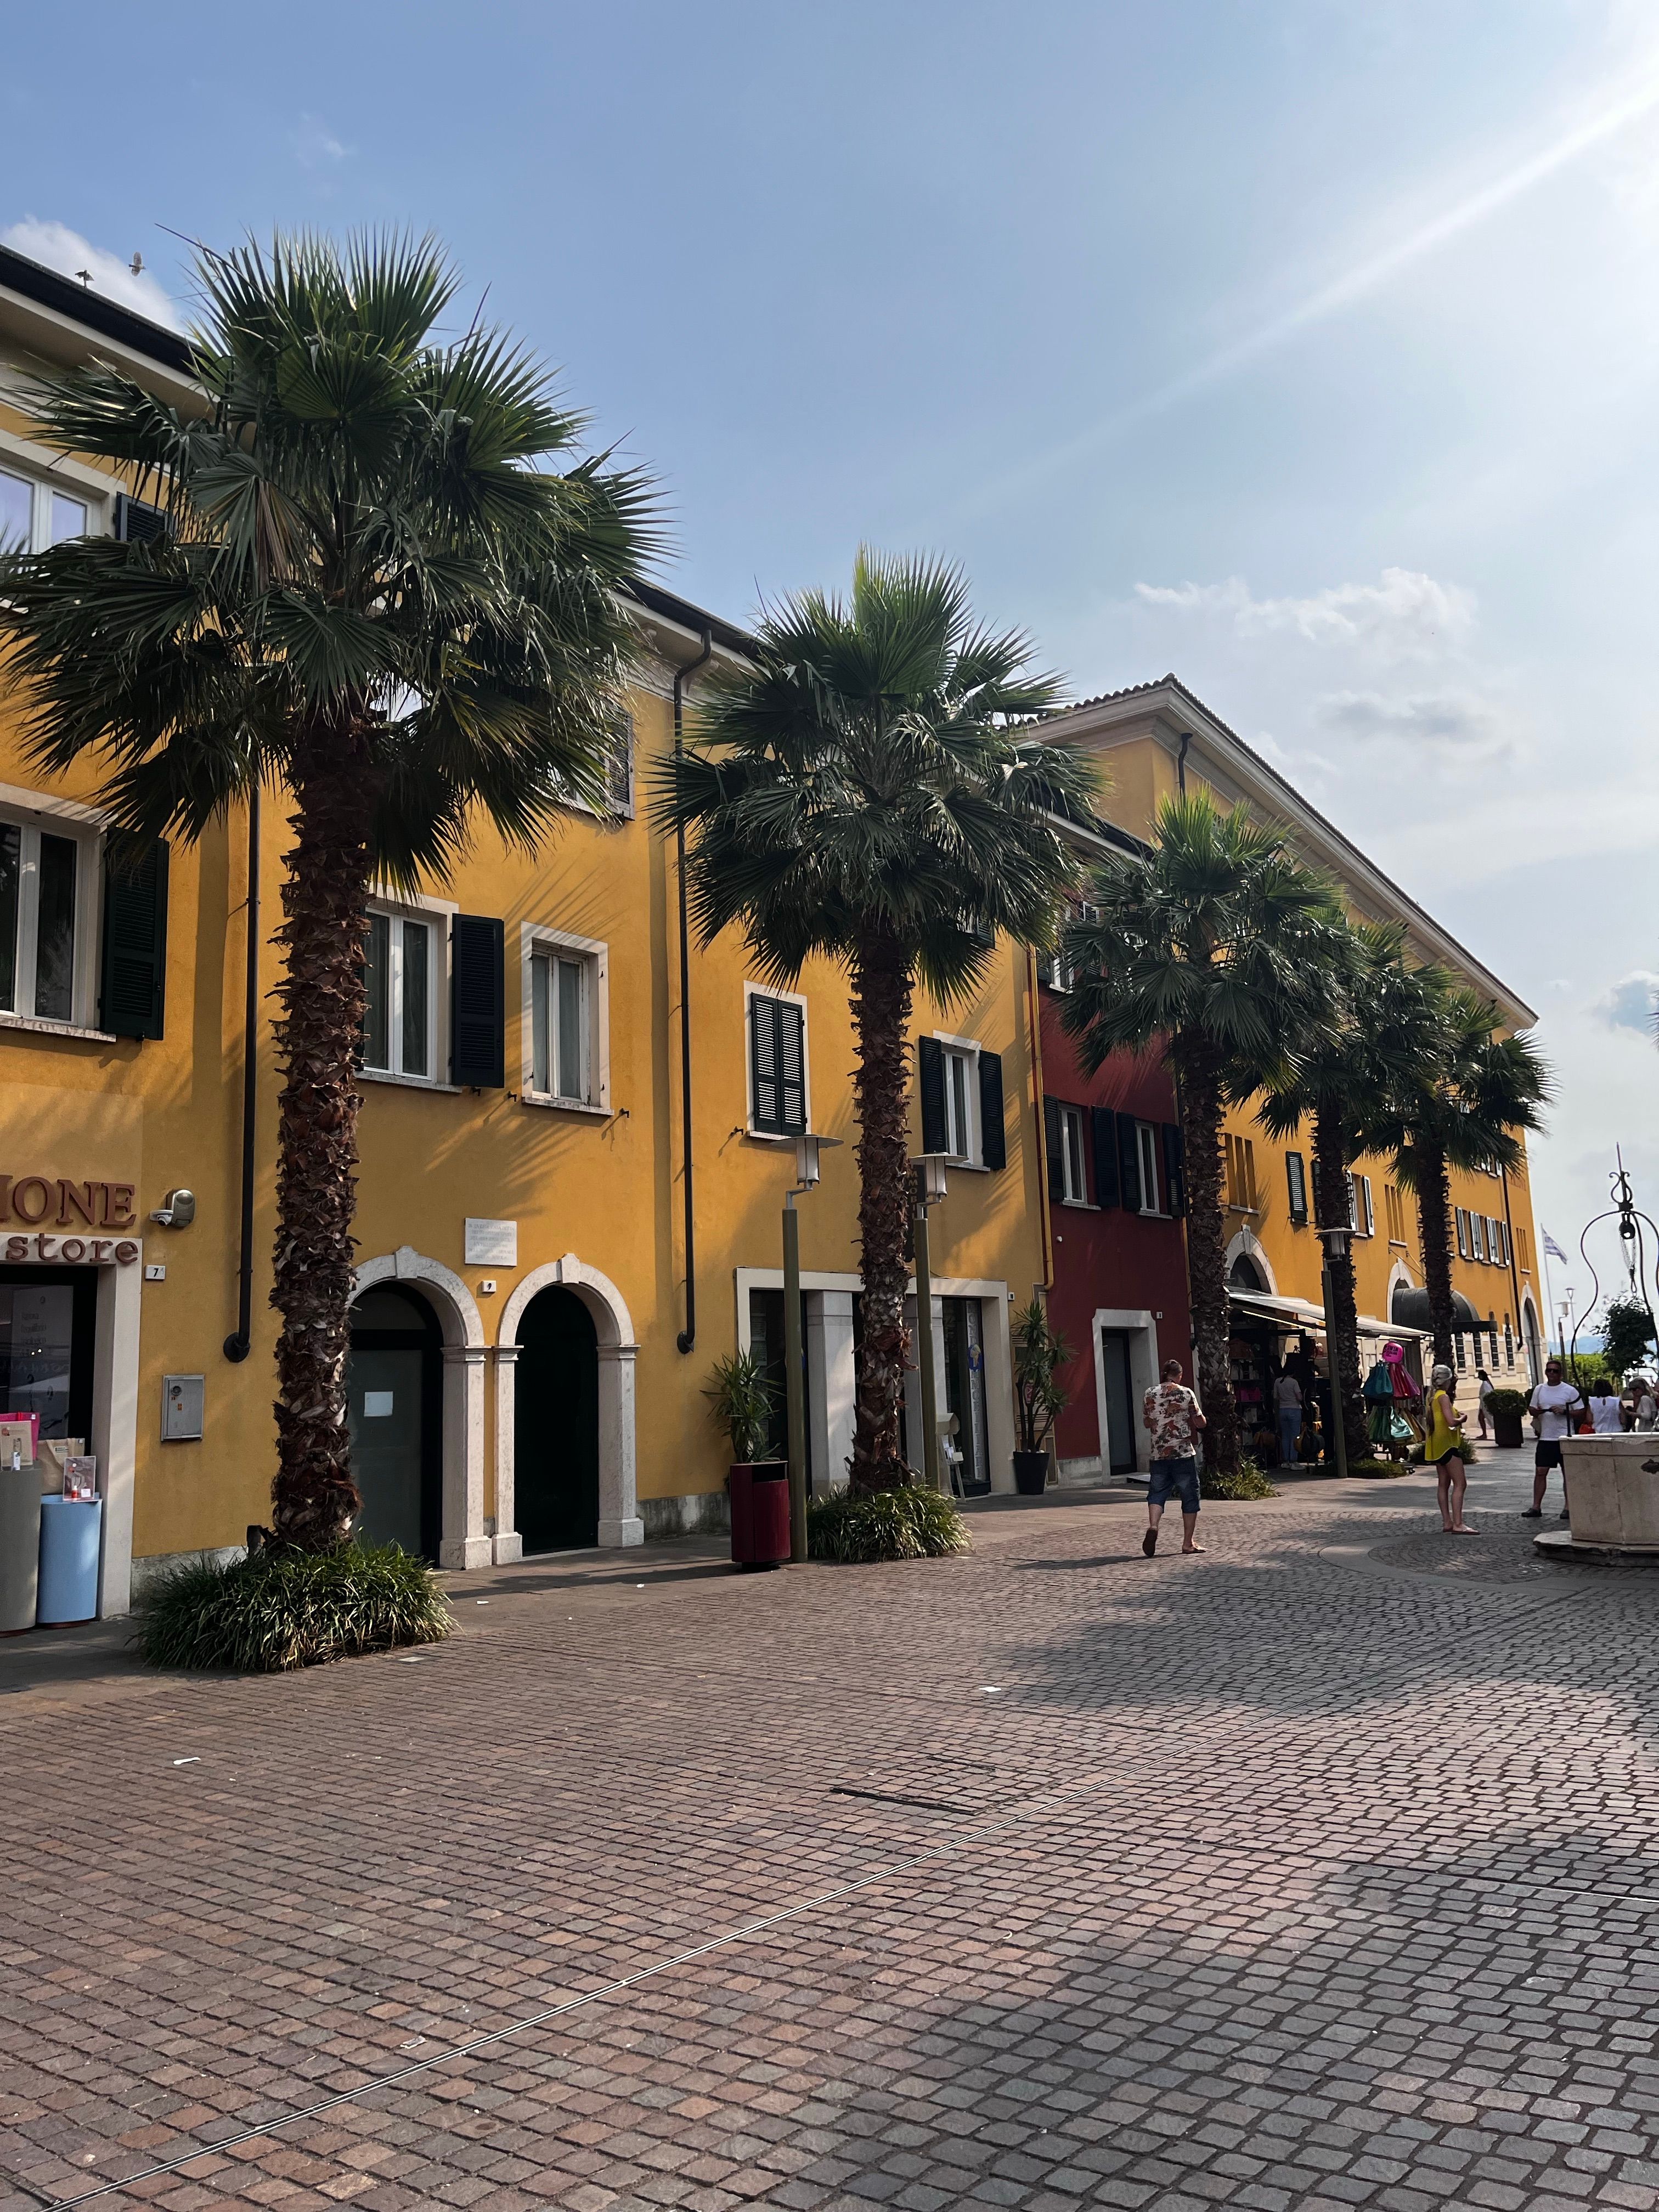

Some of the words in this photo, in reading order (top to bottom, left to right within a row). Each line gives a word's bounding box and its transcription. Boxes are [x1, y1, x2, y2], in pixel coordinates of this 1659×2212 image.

[6, 1233, 138, 1263] store
[154, 1268, 159, 1277] 7
[487, 1283, 492, 1291] 9
